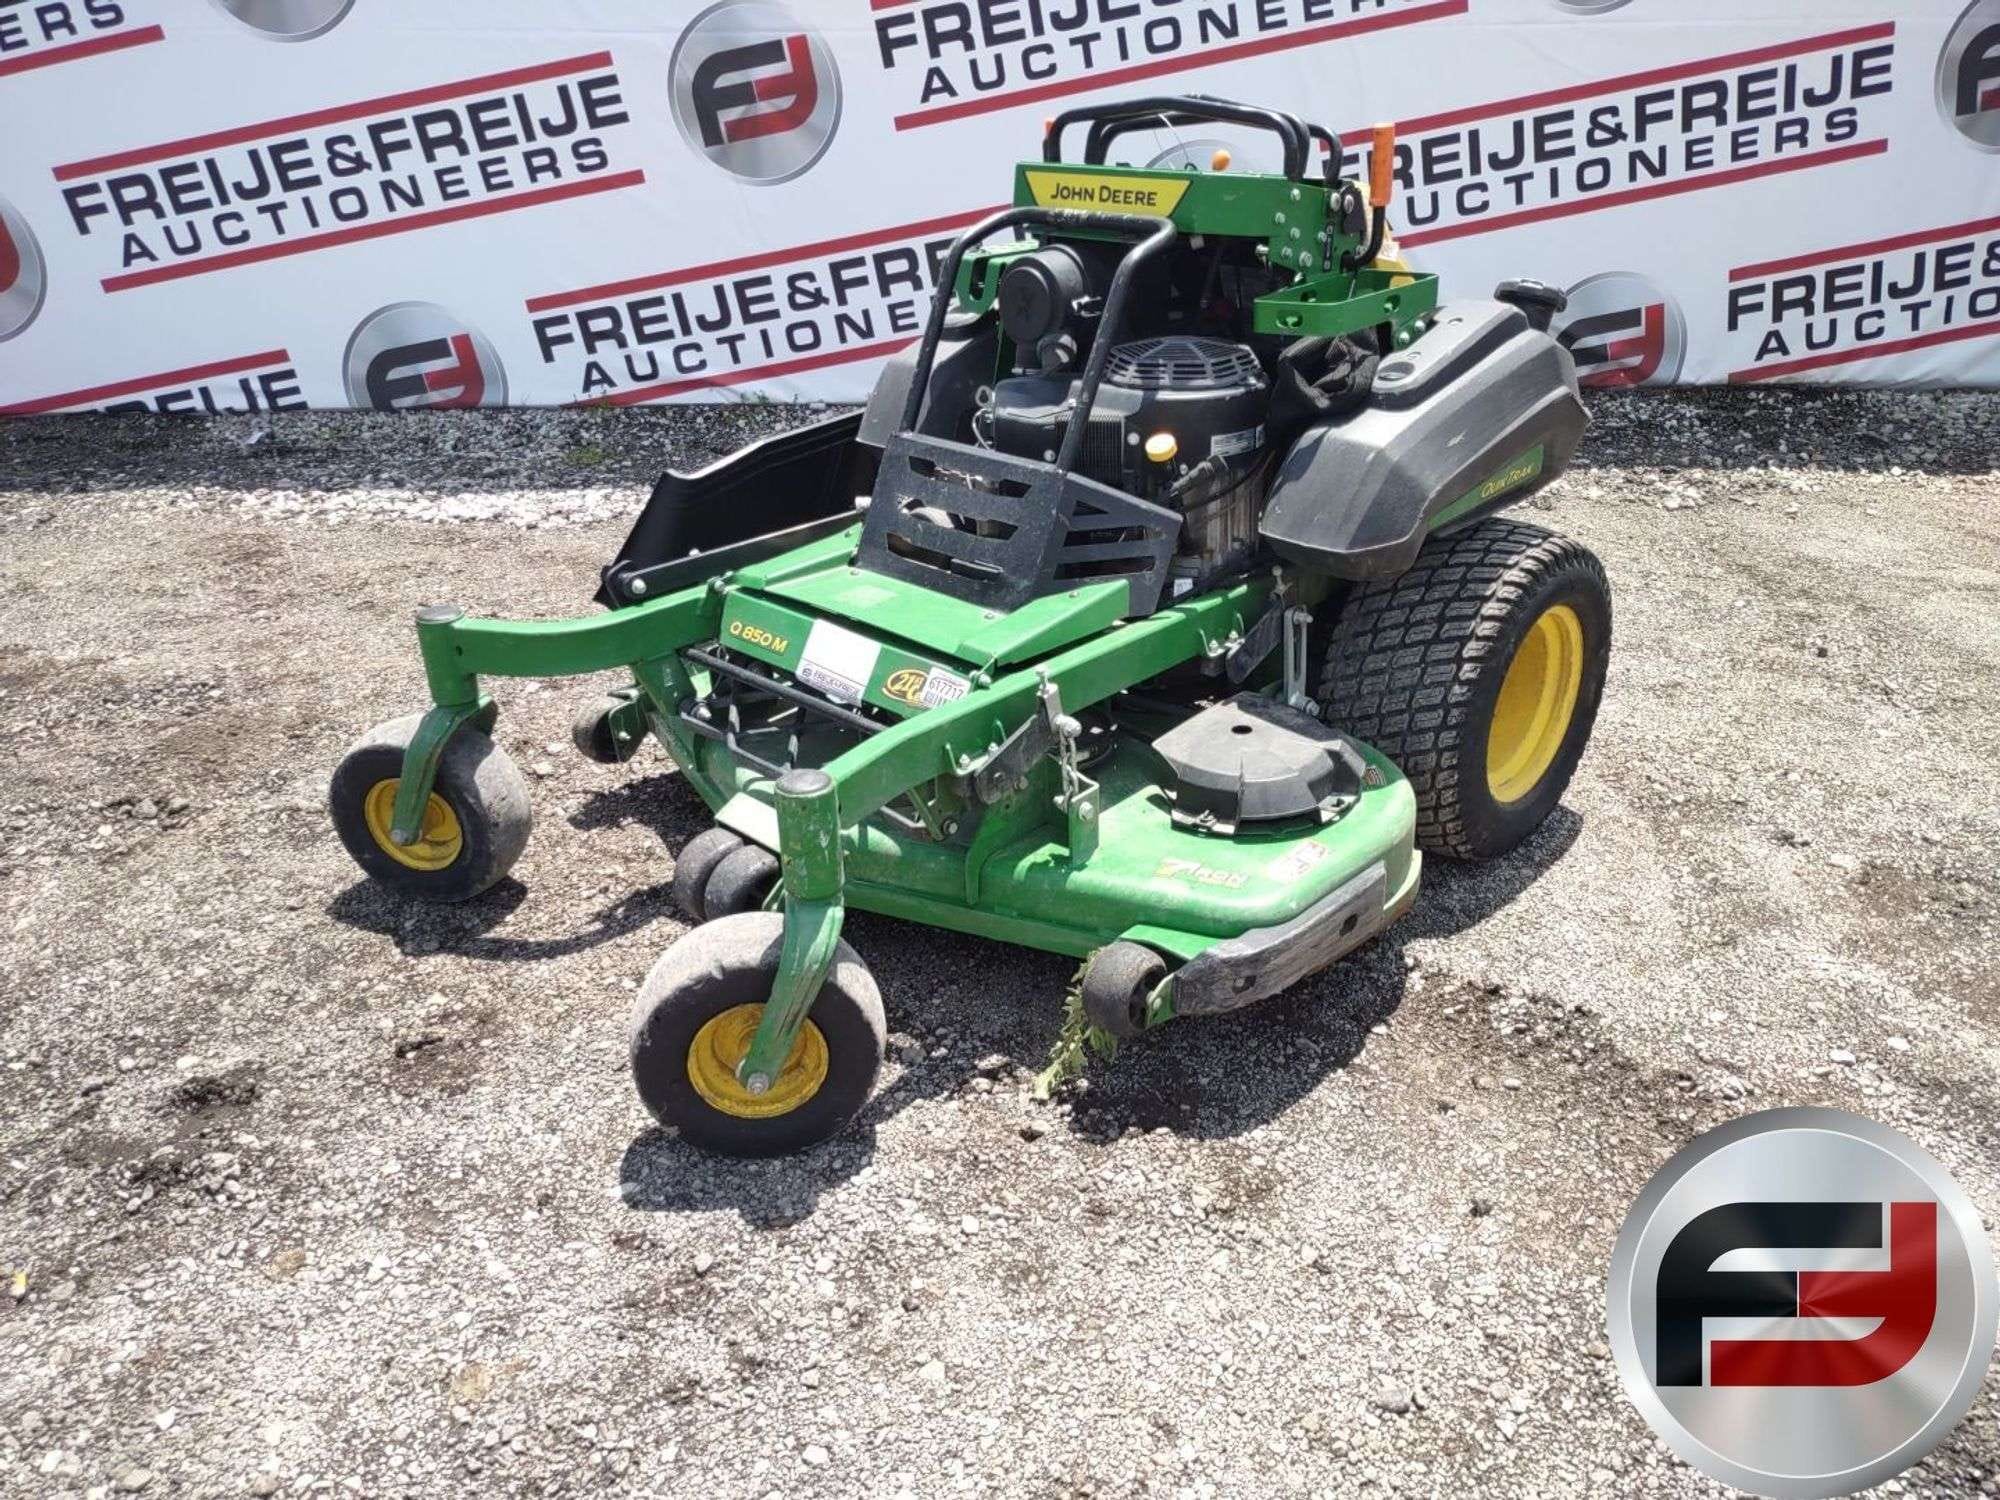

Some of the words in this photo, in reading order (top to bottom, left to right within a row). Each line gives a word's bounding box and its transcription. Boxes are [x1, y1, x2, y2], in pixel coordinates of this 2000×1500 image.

[920, 0, 1387, 103] AUCTIONEE
[61, 74, 630, 235] FREIJE&FREIJE
[122, 138, 609, 268] AUCTIONEERS
[1051, 183, 1095, 202] JOHN
[1100, 185, 1157, 206] DEERE
[1405, 106, 1858, 226] UCTIONEERS
[581, 296, 936, 393] AUCTIONE
[730, 621, 742, 636] Q
[743, 626, 771, 646] 850
[771, 636, 789, 653] M
